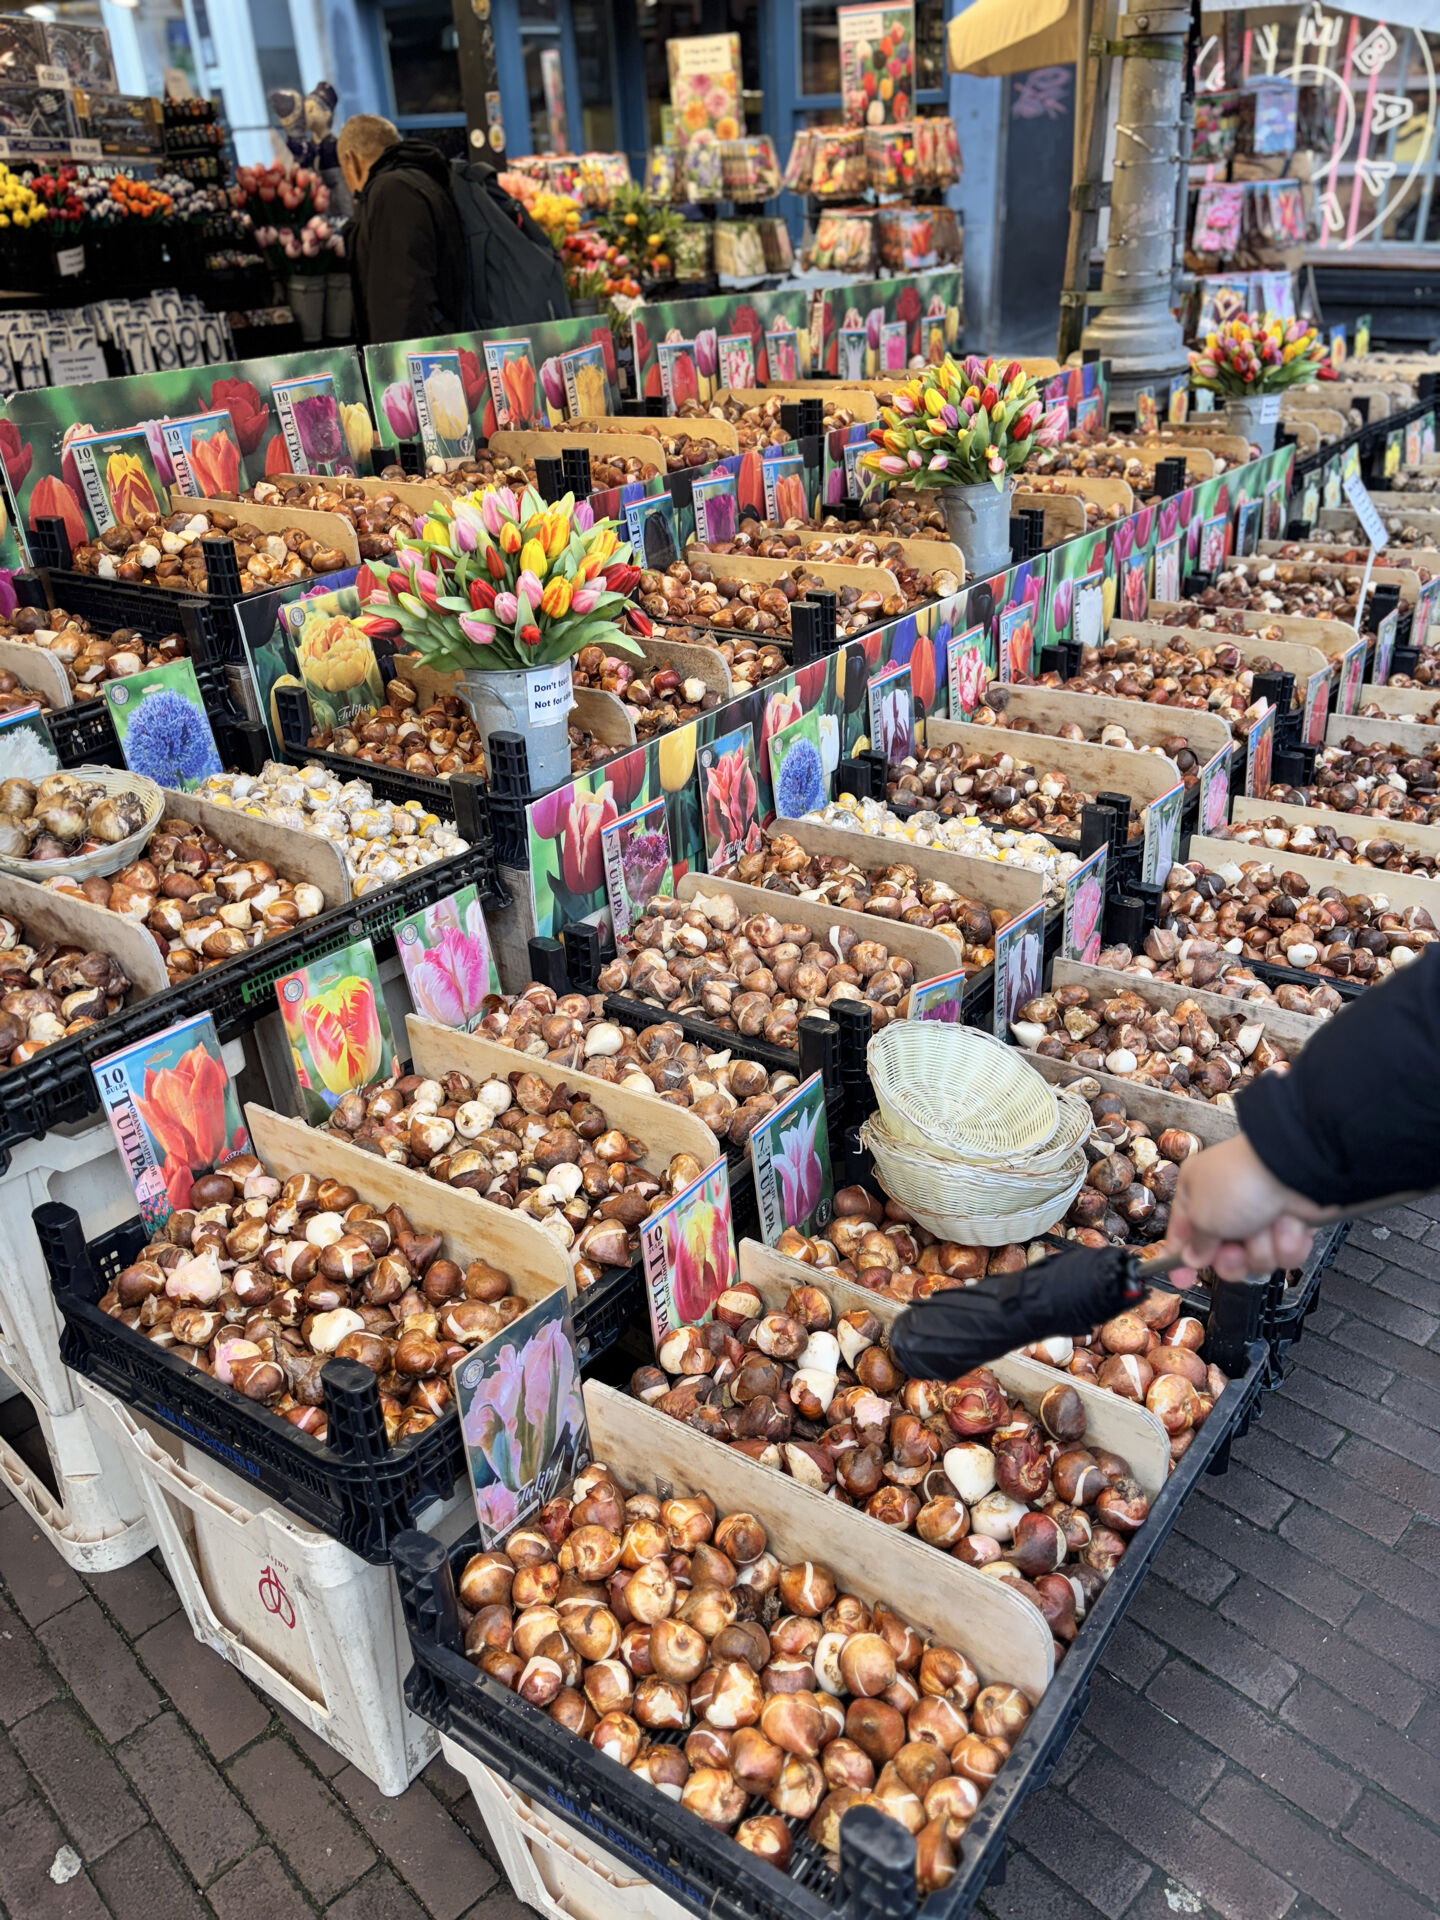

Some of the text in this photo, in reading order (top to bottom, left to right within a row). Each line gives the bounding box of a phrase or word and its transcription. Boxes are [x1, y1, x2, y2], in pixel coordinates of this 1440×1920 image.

[487, 350, 496, 359] 10
[411, 362, 420, 372] 10
[564, 361, 573, 371] 10
[277, 392, 288, 402] 10
[566, 373, 579, 417] TULIP
[167, 430, 180, 442] 10
[281, 406, 301, 463] TULIPA
[76, 447, 91, 460] 10
[82, 464, 108, 526] TULIPA
[694, 489, 703, 499] 10
[628, 511, 638, 523] 10
[534, 682, 556, 693] Don't
[535, 700, 551, 709] Not
[553, 697, 562, 706] for
[607, 833, 614, 847] 7
[608, 849, 623, 917] TULIPA
[101, 1068, 124, 1089] 10
[106, 1081, 128, 1095] BULBS
[110, 1089, 147, 1181] TULIPA
[129, 1107, 145, 1141] ORANGE
[140, 1139, 158, 1178] EMPEROR
[758, 1135, 765, 1152] 7
[758, 1151, 776, 1235] TULIPA
[646, 1225, 663, 1250] 10
[650, 1245, 669, 1337] TULIPA
[514, 1463, 563, 1510] Tulipa
[547, 1785, 706, 1905] SAM VAN SCHOOTEN BV
